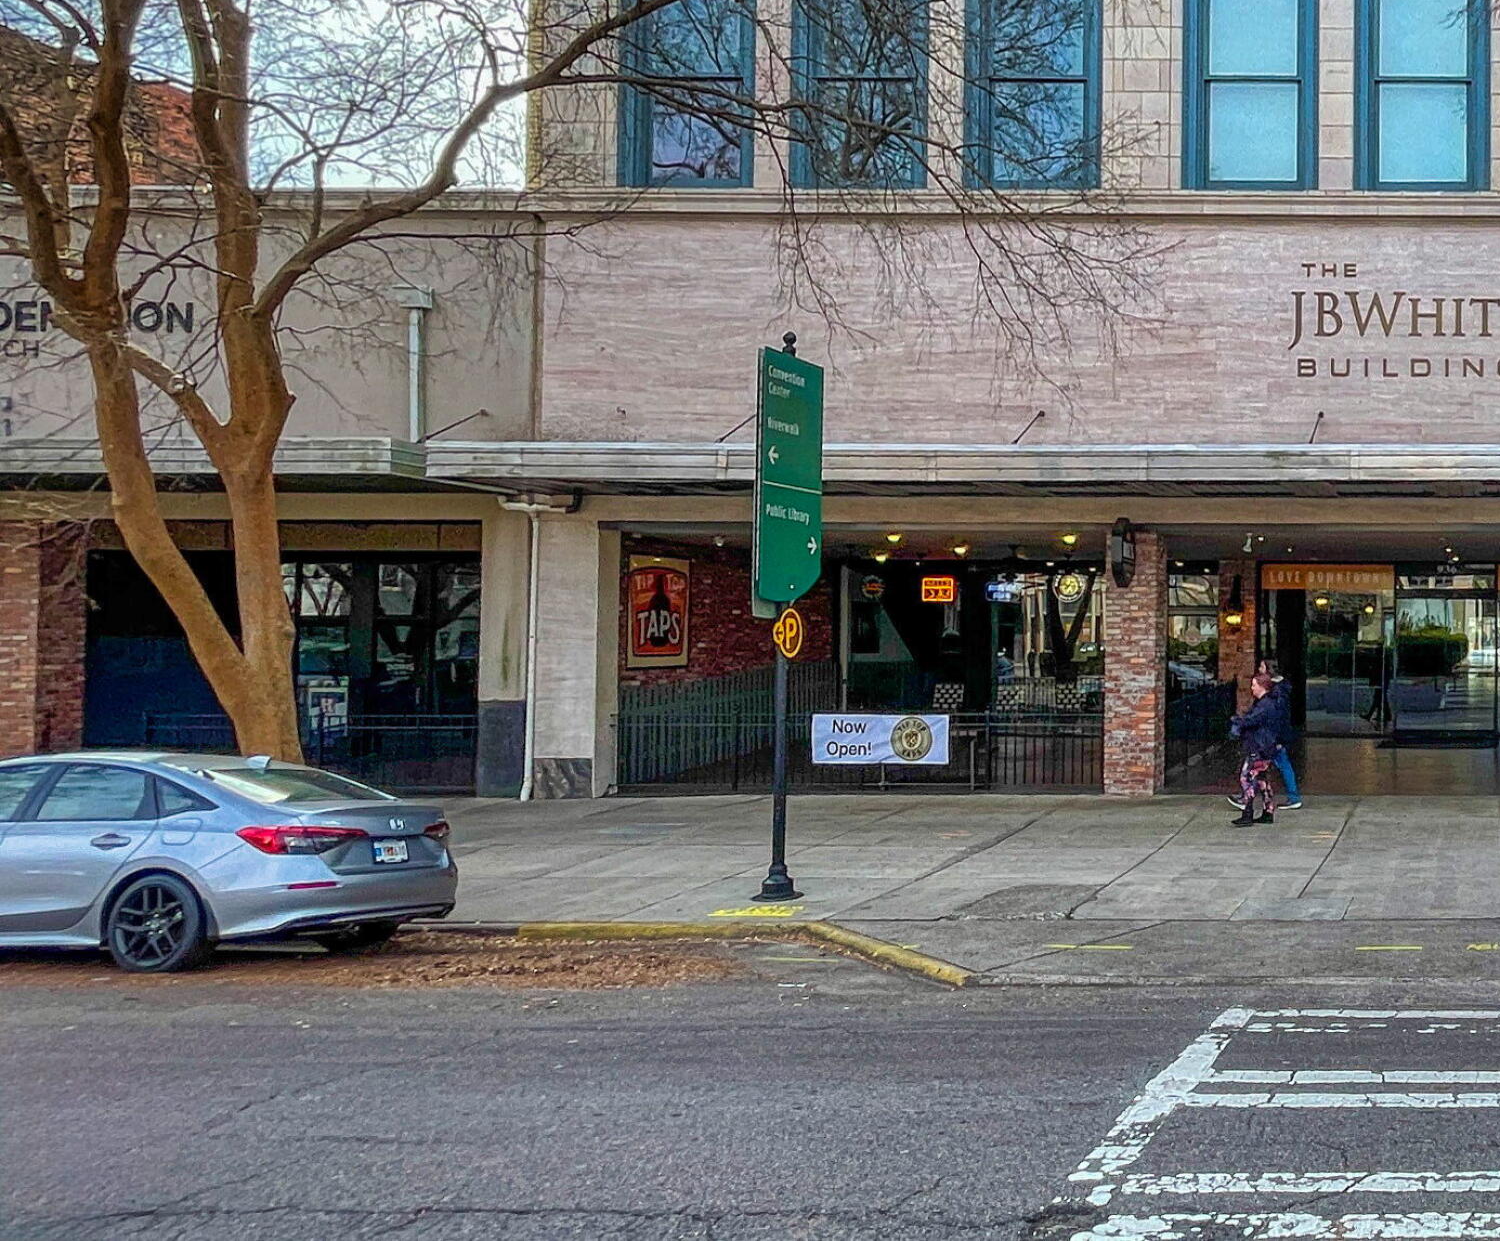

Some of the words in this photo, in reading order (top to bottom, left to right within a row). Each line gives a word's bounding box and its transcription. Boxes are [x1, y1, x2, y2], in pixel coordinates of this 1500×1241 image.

[1302, 263, 1358, 278] THE
[768, 364, 805, 388] Convention
[768, 381, 791, 399] Center
[767, 416, 799, 436] Riverwalk
[766, 503, 787, 519] Public
[788, 508, 809, 526] Library
[637, 609, 680, 645] TAPS
[785, 618, 797, 650] P
[832, 719, 867, 735] Now
[826, 742, 872, 759] Open!
